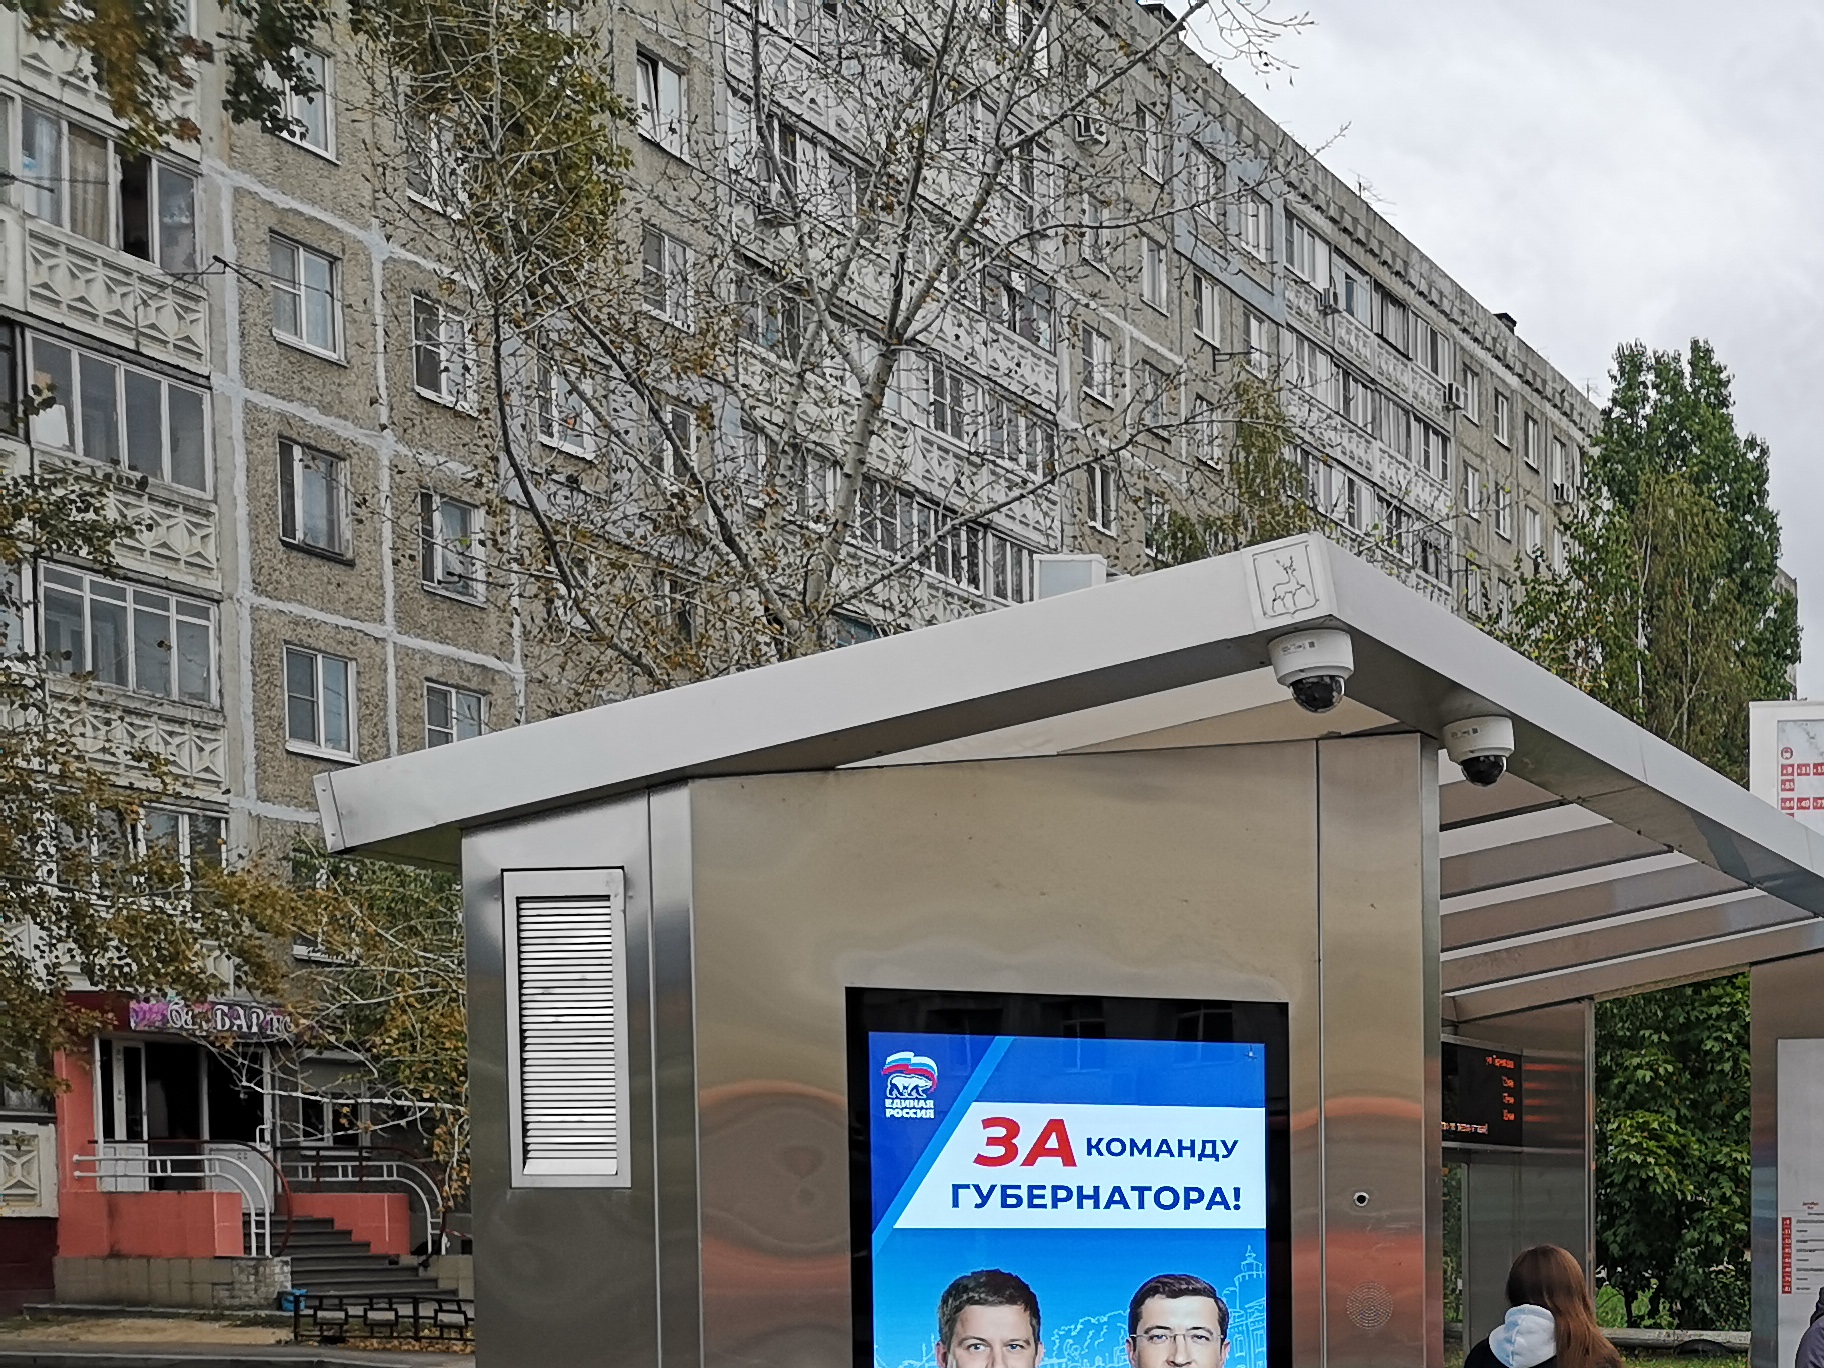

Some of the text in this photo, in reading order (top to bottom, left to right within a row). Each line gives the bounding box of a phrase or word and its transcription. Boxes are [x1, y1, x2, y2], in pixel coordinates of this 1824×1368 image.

[885, 1098, 935, 1109] ЕДИНАЯ
[885, 1109, 935, 1119] РОССИЯ
[973, 1116, 1240, 1168] ЗА КОМАНДУ
[950, 1183, 1242, 1211] ГУБЕРНАТОРА!
